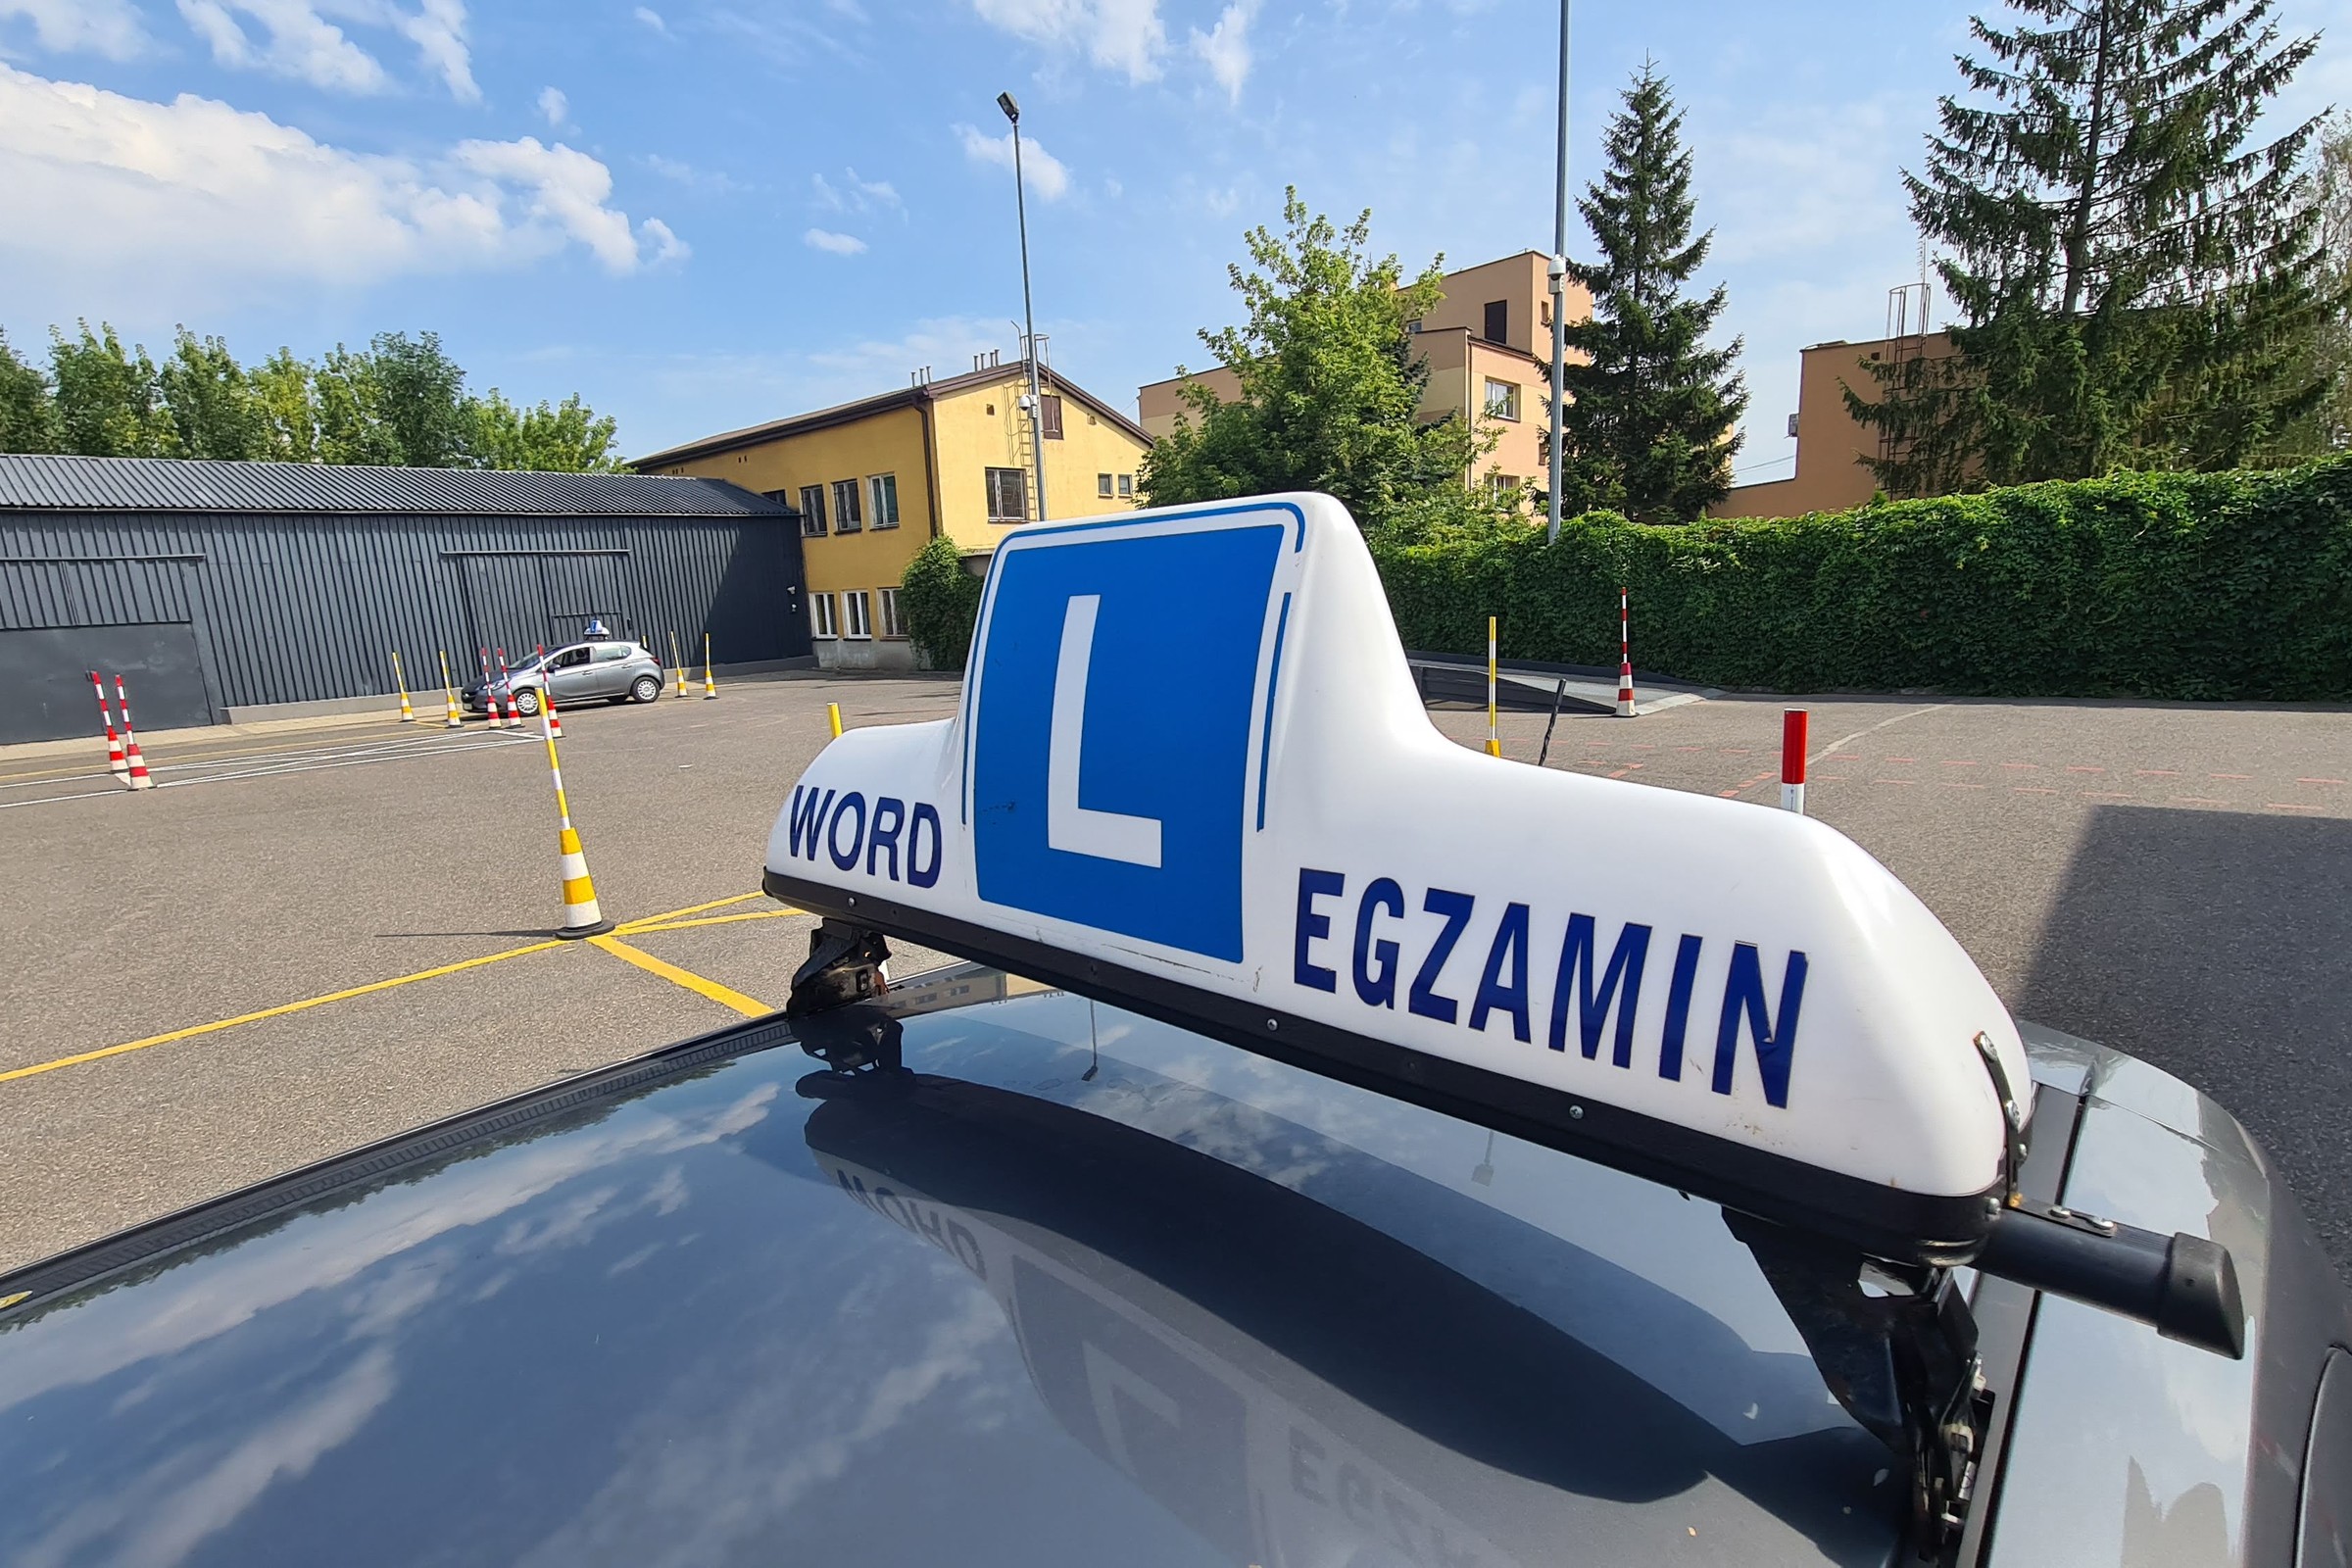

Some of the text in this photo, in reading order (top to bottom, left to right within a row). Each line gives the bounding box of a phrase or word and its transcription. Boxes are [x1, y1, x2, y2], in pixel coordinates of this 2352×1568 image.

[789, 784, 943, 889] WORD
[1047, 594, 1163, 869] L
[1293, 866, 1809, 1110] EGZAMIN
